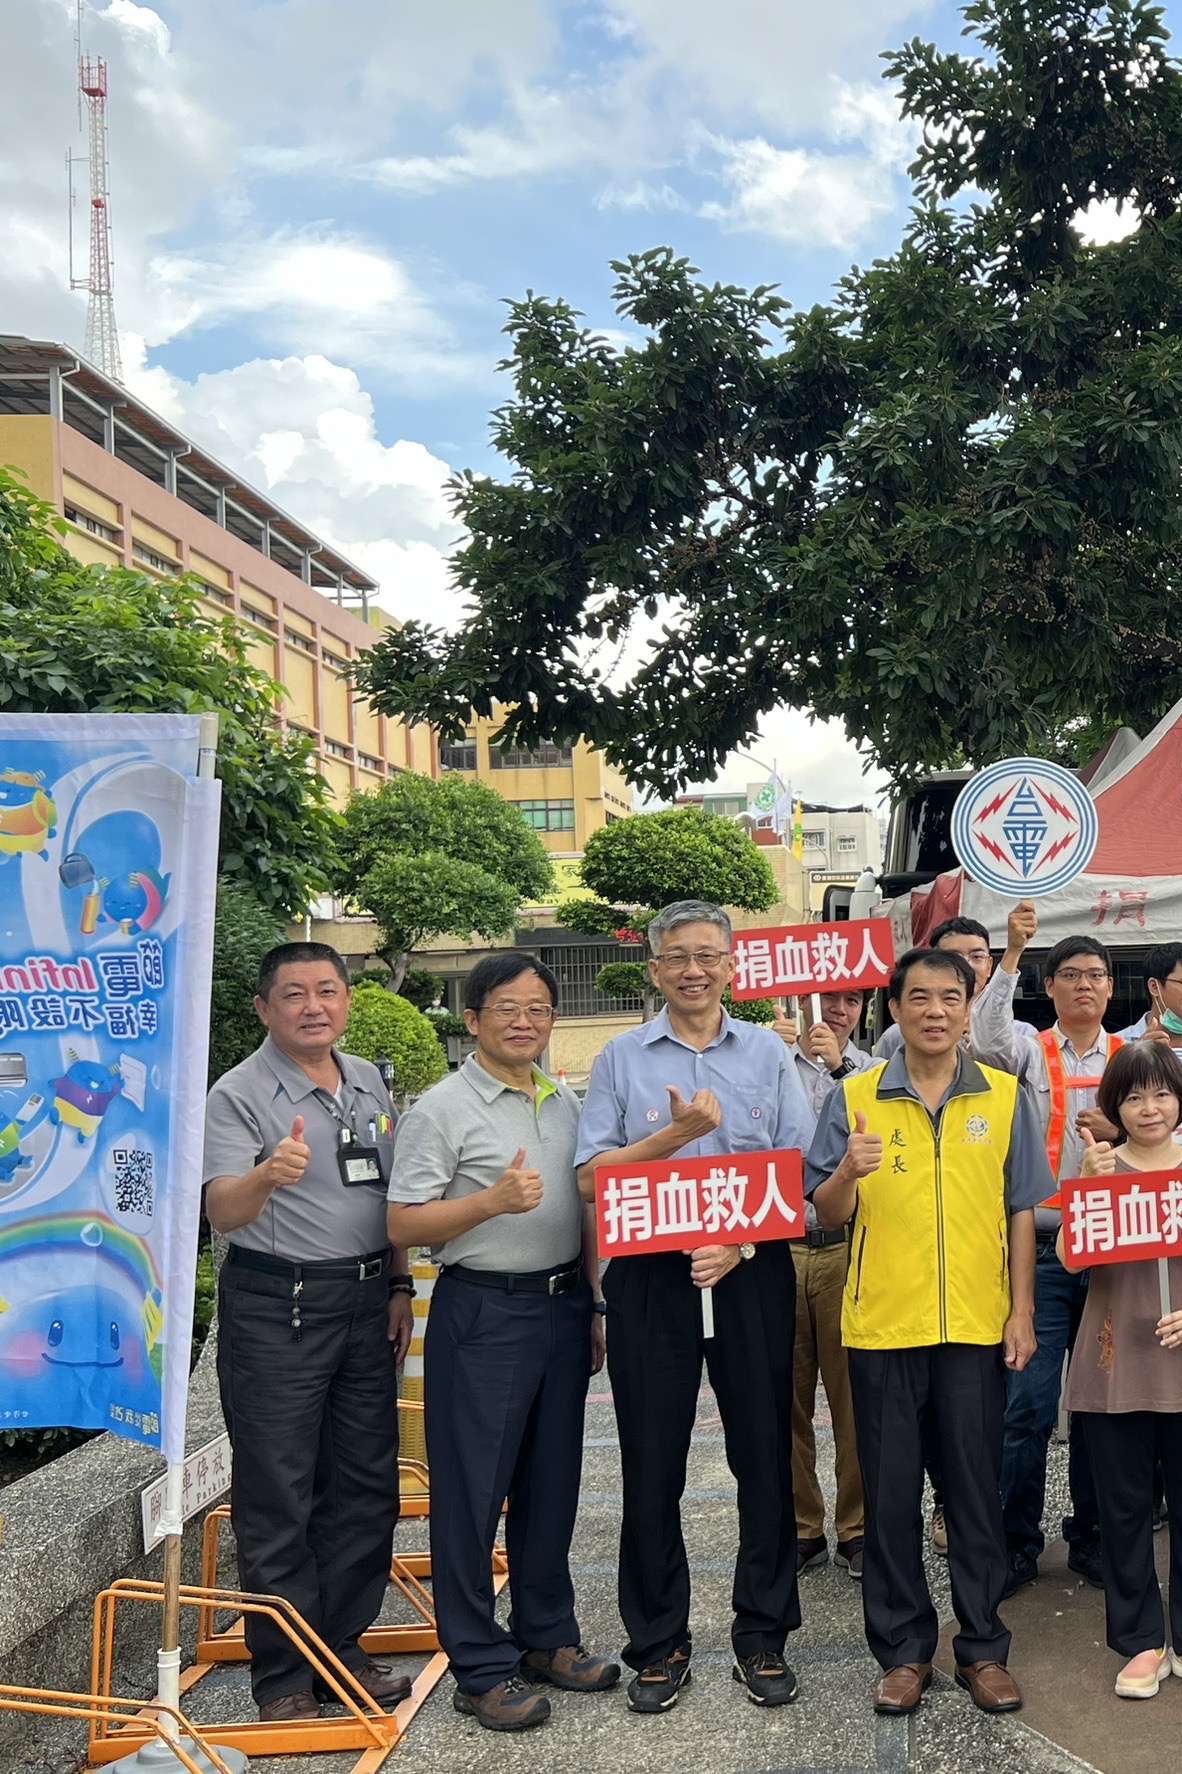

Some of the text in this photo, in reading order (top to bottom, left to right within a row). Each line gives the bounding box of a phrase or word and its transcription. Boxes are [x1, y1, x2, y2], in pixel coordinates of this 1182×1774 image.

[734, 928, 889, 991] 捐血救人
[889, 1128, 908, 1174] 處長
[603, 1161, 798, 1244] 捐血救人
[150, 1446, 225, 1522] 腳車停放
